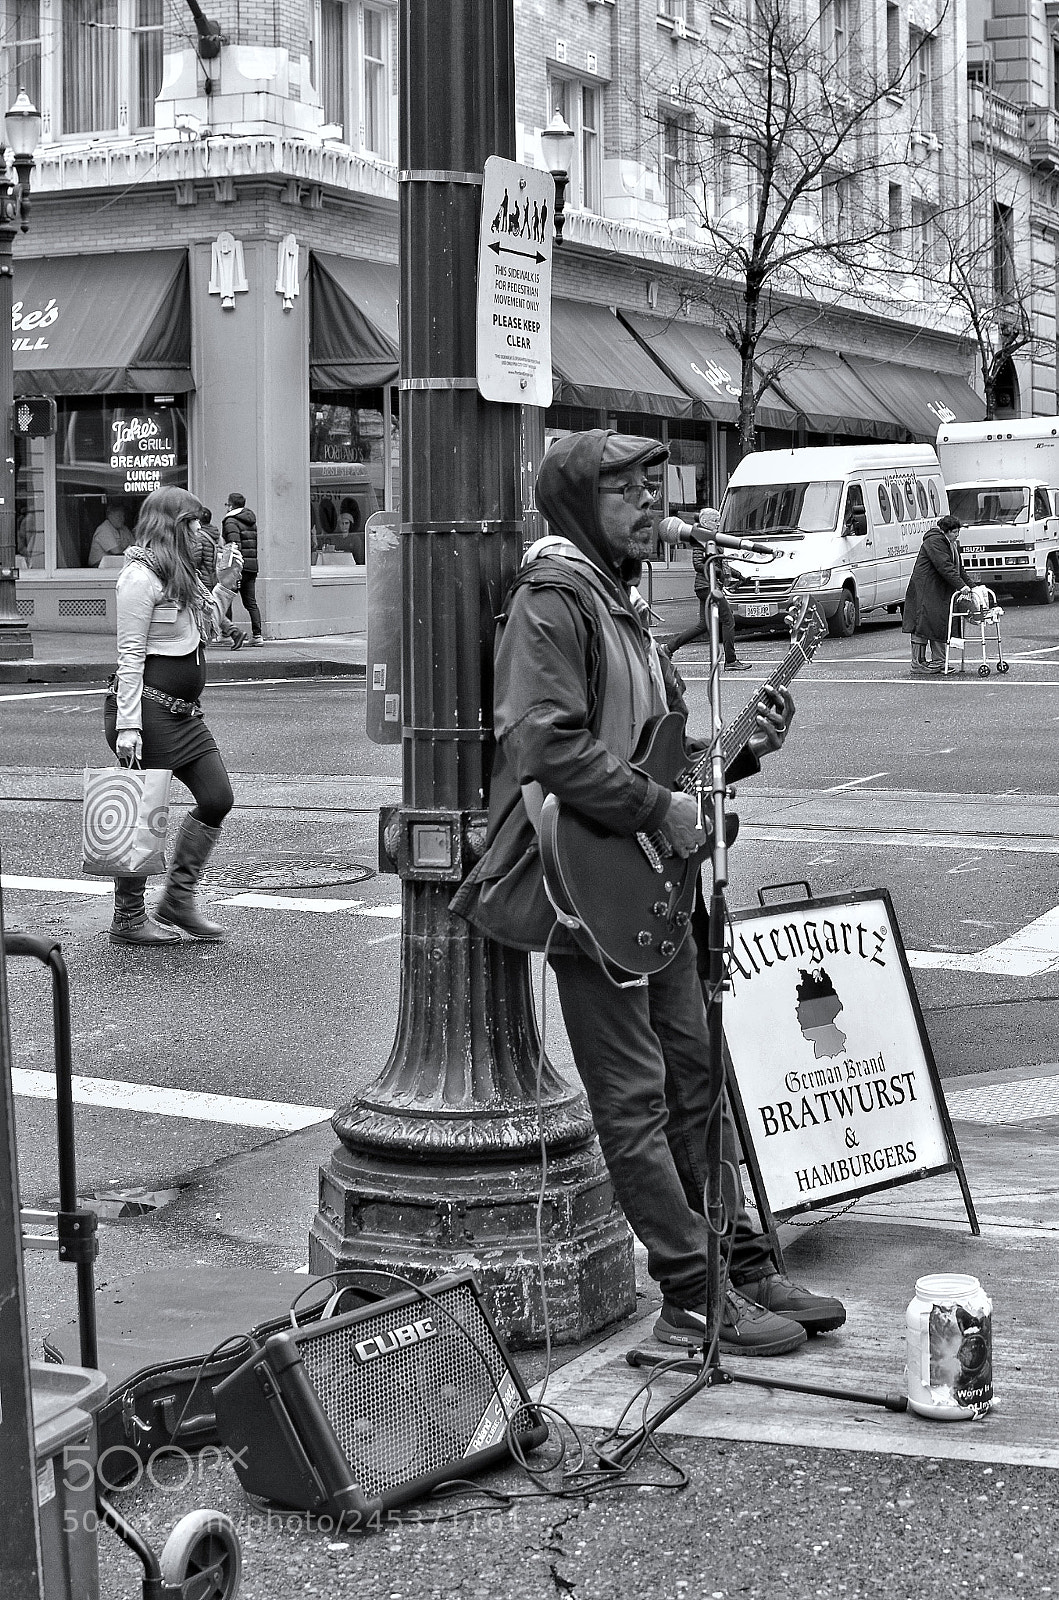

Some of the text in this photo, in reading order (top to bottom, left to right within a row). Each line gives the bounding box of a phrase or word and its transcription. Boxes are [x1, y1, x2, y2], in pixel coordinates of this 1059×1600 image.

[494, 264, 540, 284] THIS SIDEWALK IS
[494, 279, 539, 298] FOR PEDESTRIAN
[493, 293, 540, 312] MOVEMENT ONLY
[12, 298, 59, 332] ke's
[492, 313, 541, 334] PLEASE KEEP
[12, 337, 49, 351] ILL
[506, 334, 531, 350] CLEAR
[111, 417, 158, 453] Jake's
[138, 437, 172, 451] GRILL
[110, 453, 176, 468] BREAKFAST
[126, 470, 160, 481] LUNCH
[124, 481, 161, 493] DINNER
[878, 480, 940, 521] event
[784, 1051, 886, 1093] German Brand
[757, 1070, 918, 1138] BRATWURST
[844, 1126, 860, 1149] &
[794, 1141, 918, 1192] HAMBURGERS
[354, 1316, 438, 1361] CUBE
[957, 1387, 984, 1398] Worry
[472, 1417, 493, 1451] Roland
